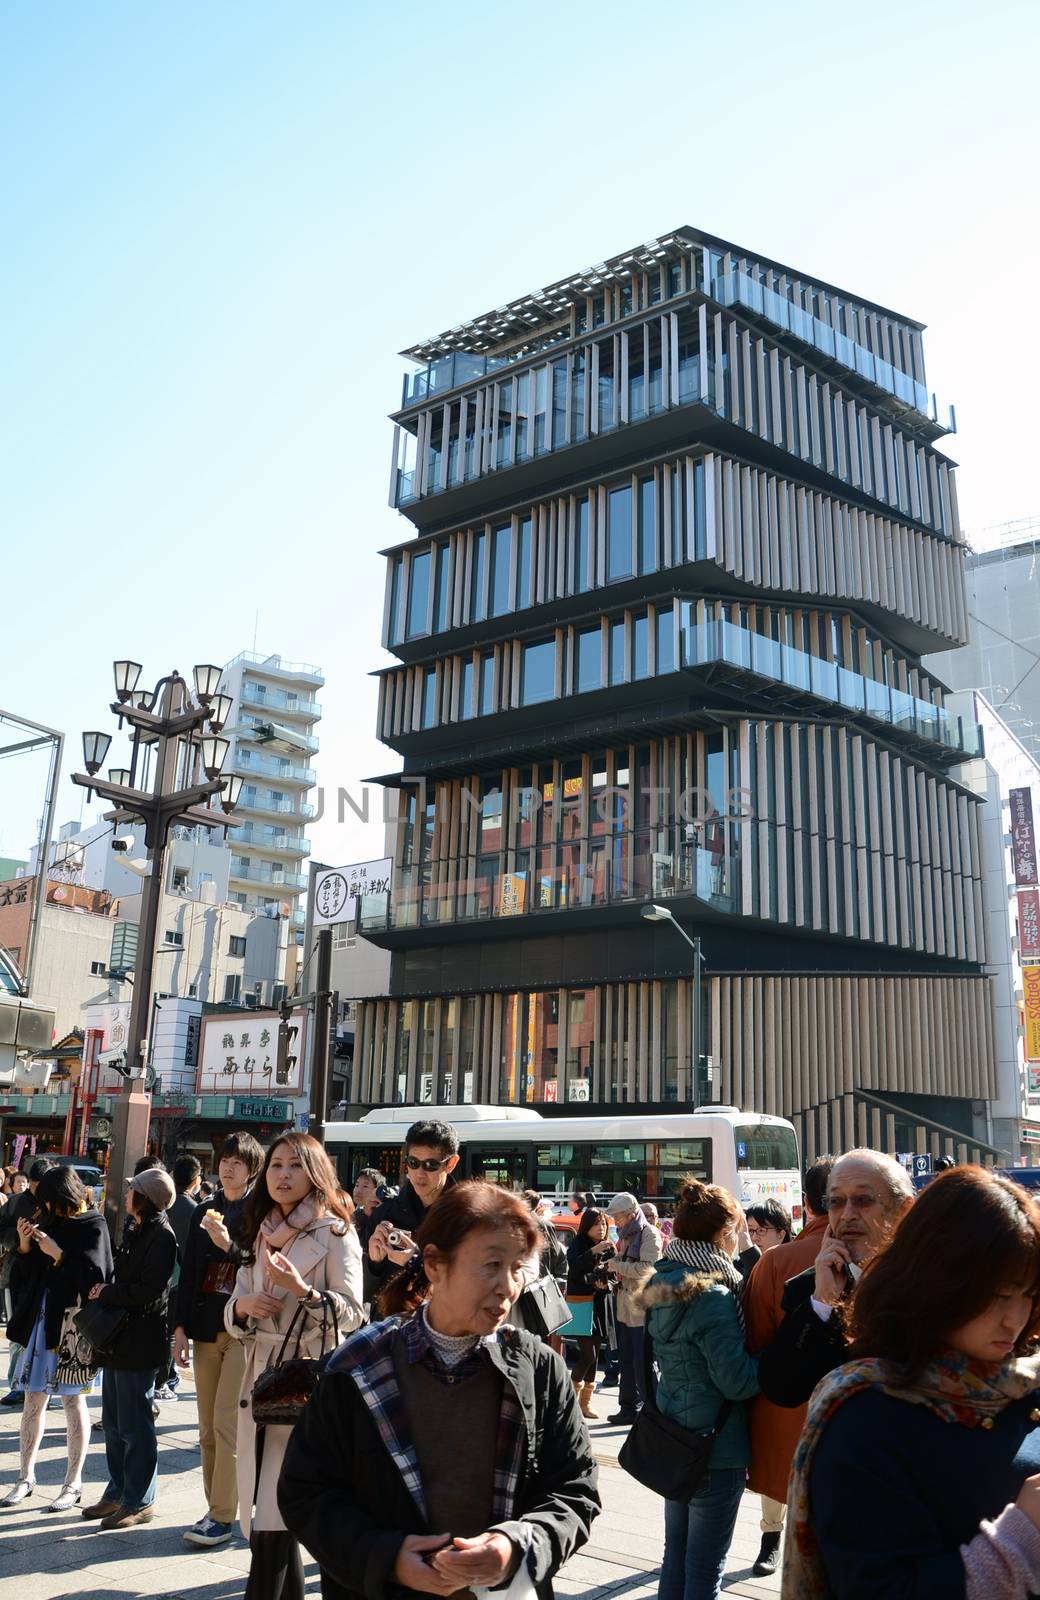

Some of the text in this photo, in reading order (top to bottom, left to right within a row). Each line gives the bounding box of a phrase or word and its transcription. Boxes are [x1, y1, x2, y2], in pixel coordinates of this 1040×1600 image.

[322, 880, 331, 914] 西むら
[222, 1056, 272, 1078] 西むら
